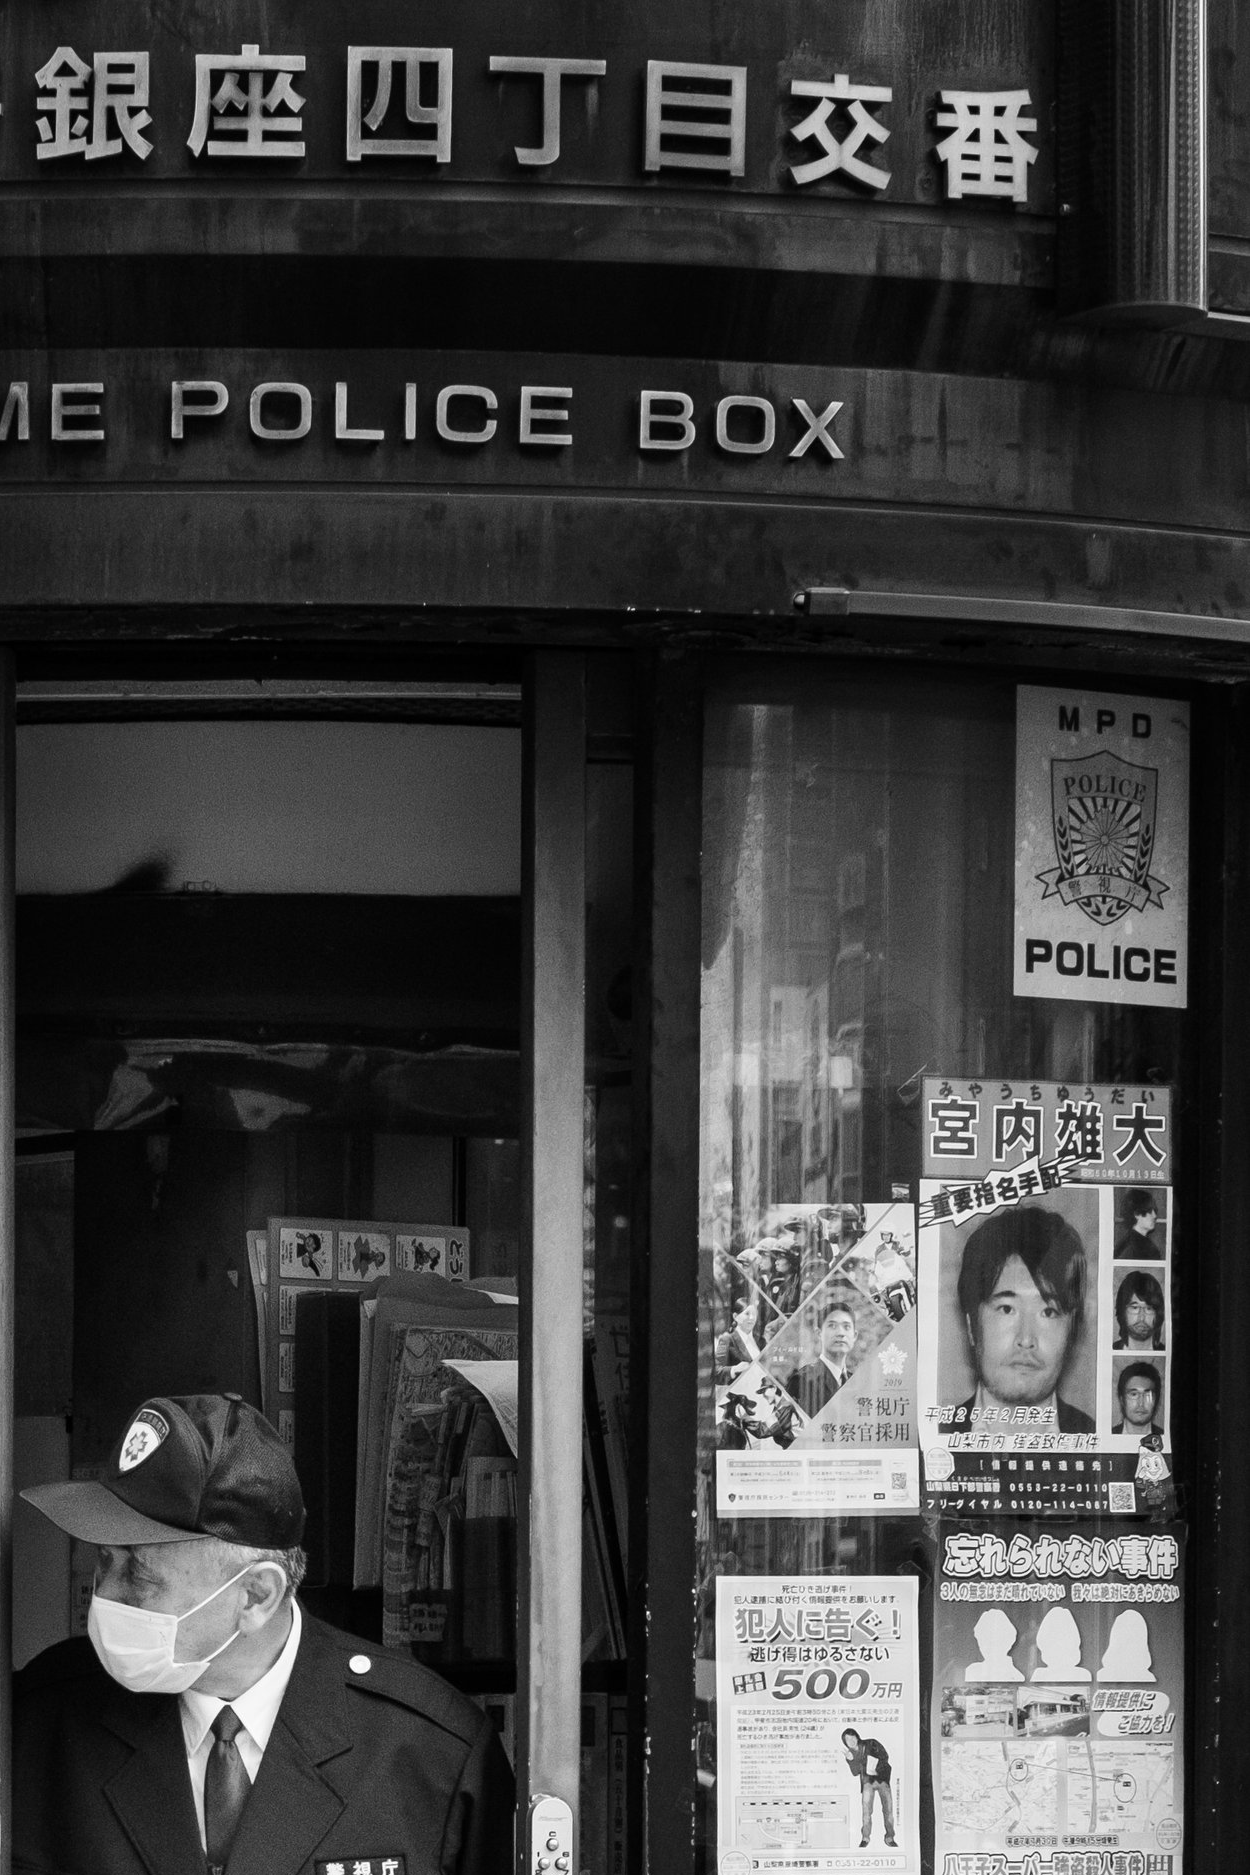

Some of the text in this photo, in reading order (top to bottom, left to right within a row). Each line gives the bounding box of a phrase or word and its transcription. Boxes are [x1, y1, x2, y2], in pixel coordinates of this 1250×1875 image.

[171, 381, 575, 448] POLICE
[640, 390, 846, 460] BOX
[1059, 706, 1152, 739] MPD
[1063, 775, 1146, 803] POLICE
[1067, 875, 1140, 902] 警視庁
[1025, 938, 1178, 985] POLICE
[928, 1096, 1167, 1167] 宮内雄大
[931, 1163, 1063, 1220] 重要指名手配
[884, 1378, 903, 1387] 2019
[857, 1397, 911, 1417] 警視庁
[924, 1405, 1057, 1425] 平成25年2月発生
[821, 1423, 911, 1443] 警察官採用
[1010, 1482, 1108, 1493] 0553-22-0110
[943, 1534, 1179, 1580] 忘れられない事件
[940, 1582, 1181, 1603] 3人の無念はまだ晴れていない 我々は絶対にあきらめない
[735, 1608, 901, 1643] 犯人に告ぐ！
[750, 1646, 890, 1662] 逃げ得はゆるさない
[771, 1669, 903, 1701] 500万円
[1092, 1690, 1156, 1711] 情報提供に
[1117, 1713, 1177, 1735] ご協力を！
